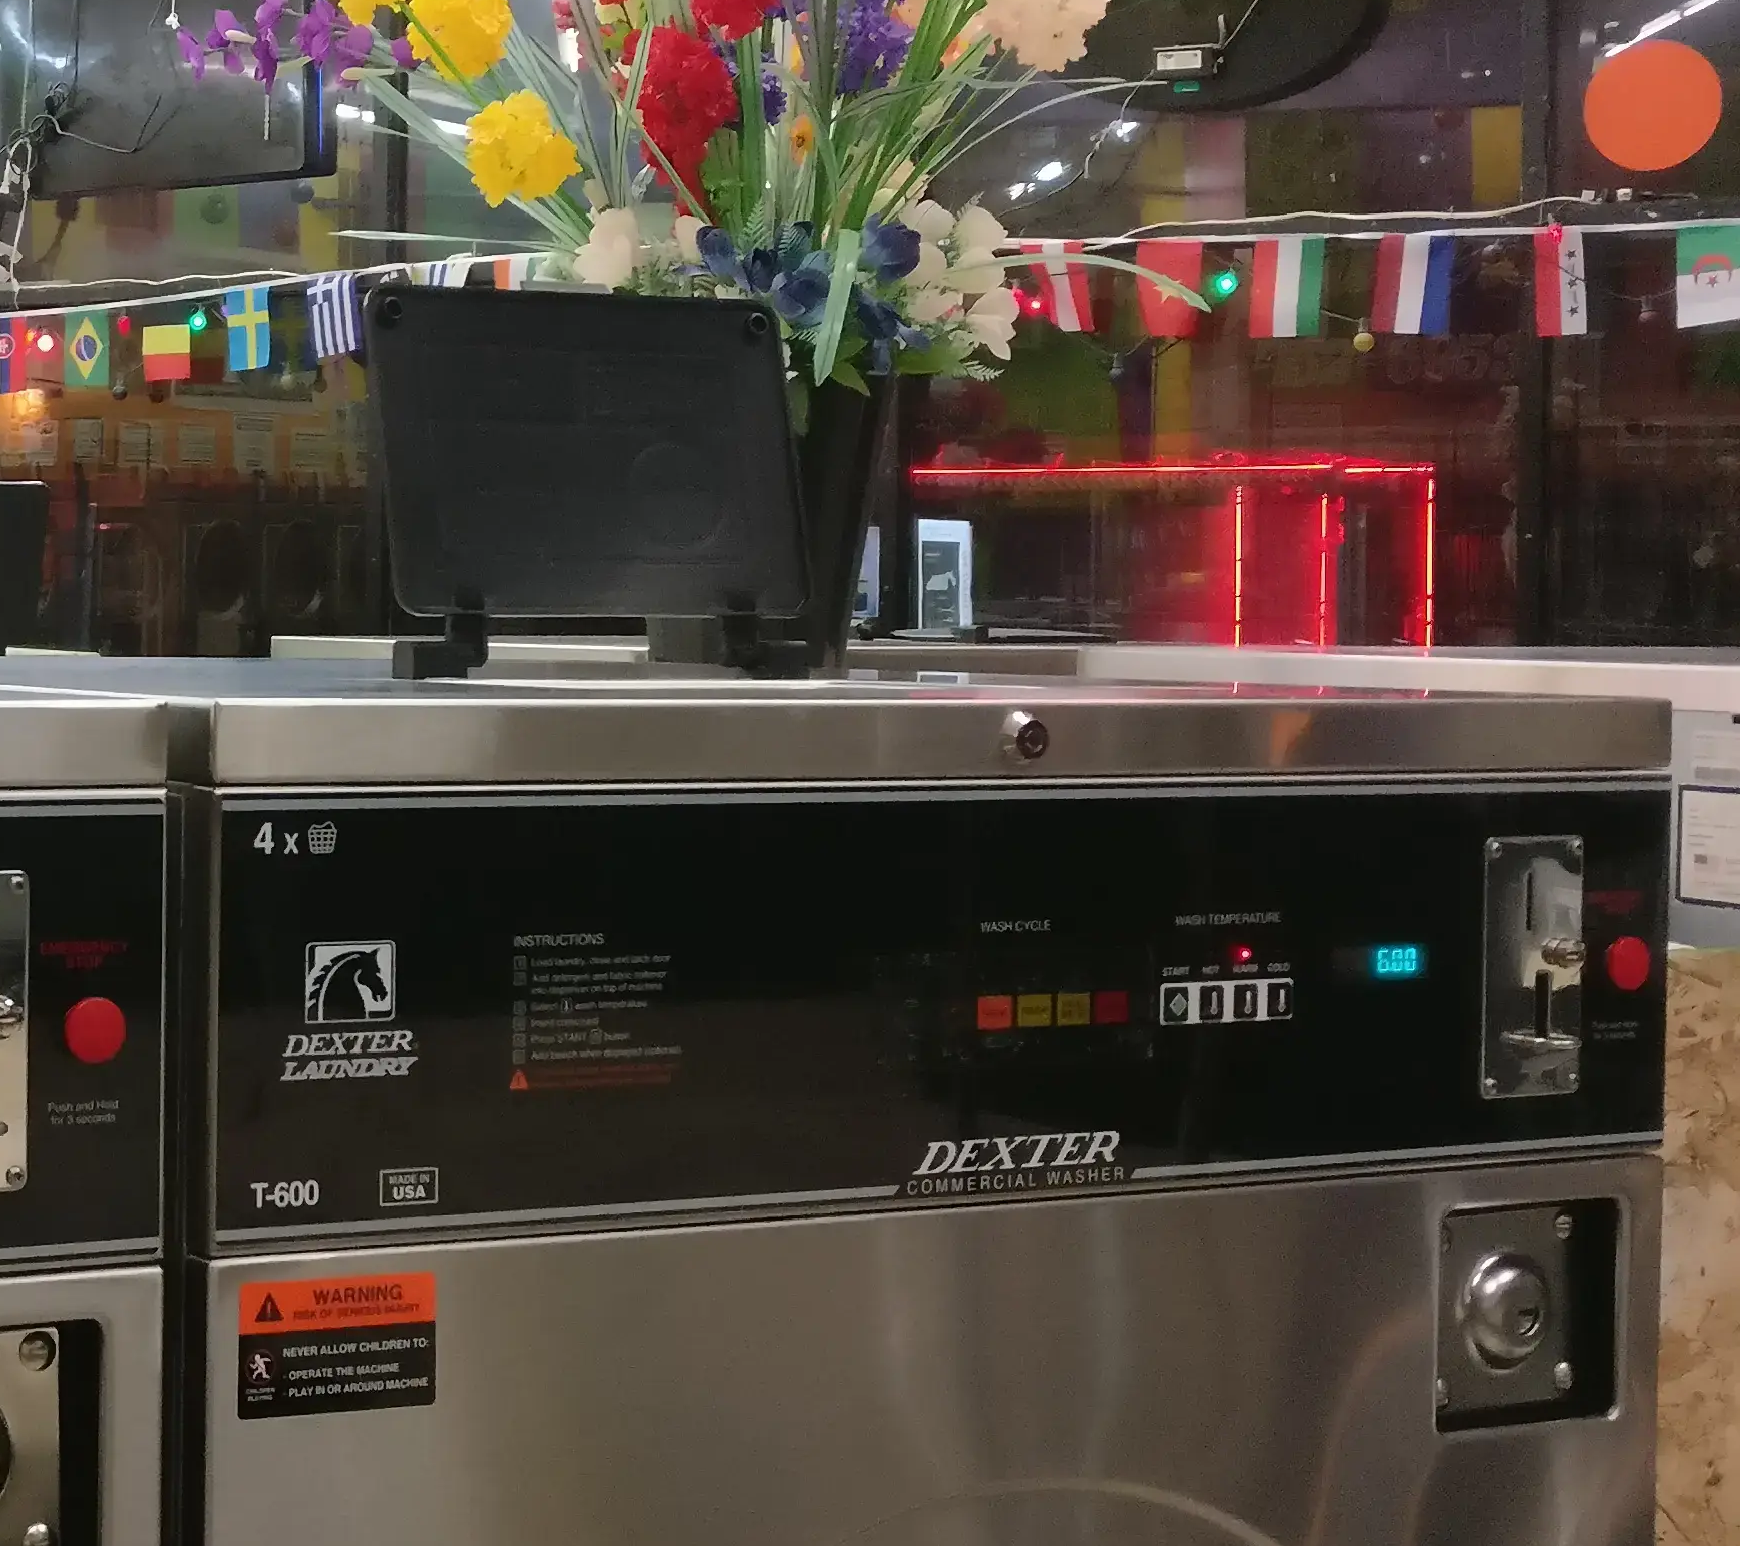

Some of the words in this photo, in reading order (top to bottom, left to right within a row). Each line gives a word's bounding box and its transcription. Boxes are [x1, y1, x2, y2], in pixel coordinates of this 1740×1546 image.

[254, 822, 275, 854] 4
[283, 832, 299, 855] x
[981, 921, 1012, 933] WASH
[1015, 919, 1051, 932] CYCLE
[1175, 915, 1205, 926] WASH
[1209, 912, 1281, 926] TEMPERATURE
[513, 933, 605, 947] INSTRUCTIONS
[282, 1030, 413, 1057] DEXTER
[280, 1057, 418, 1081] LAUNDRY
[48, 1101, 73, 1114] Push
[76, 1100, 94, 1112] and
[76, 1113, 116, 1125] seconds
[912, 1130, 1121, 1177] DEXTER
[389, 1174, 419, 1185] MADE
[420, 1173, 430, 1183] IN
[906, 1170, 1037, 1196] COMMERCIAL
[1046, 1165, 1125, 1187] WASHER
[250, 1179, 319, 1209] T-600
[392, 1184, 426, 1200] USA
[313, 1284, 403, 1305] WARNING
[320, 1309, 334, 1320] OF
[283, 1345, 318, 1358] NEVER
[320, 1343, 357, 1355] ALLOW
[360, 1339, 410, 1353] CHILDREN
[288, 1367, 333, 1380] OPERATE
[336, 1365, 354, 1376] THE
[357, 1363, 400, 1375] MACHINE
[288, 1386, 314, 1398] PLAY
[315, 1385, 325, 1395] IN
[327, 1383, 341, 1394] OR
[343, 1380, 383, 1394] AROUND
[386, 1377, 429, 1390] MACHINE
